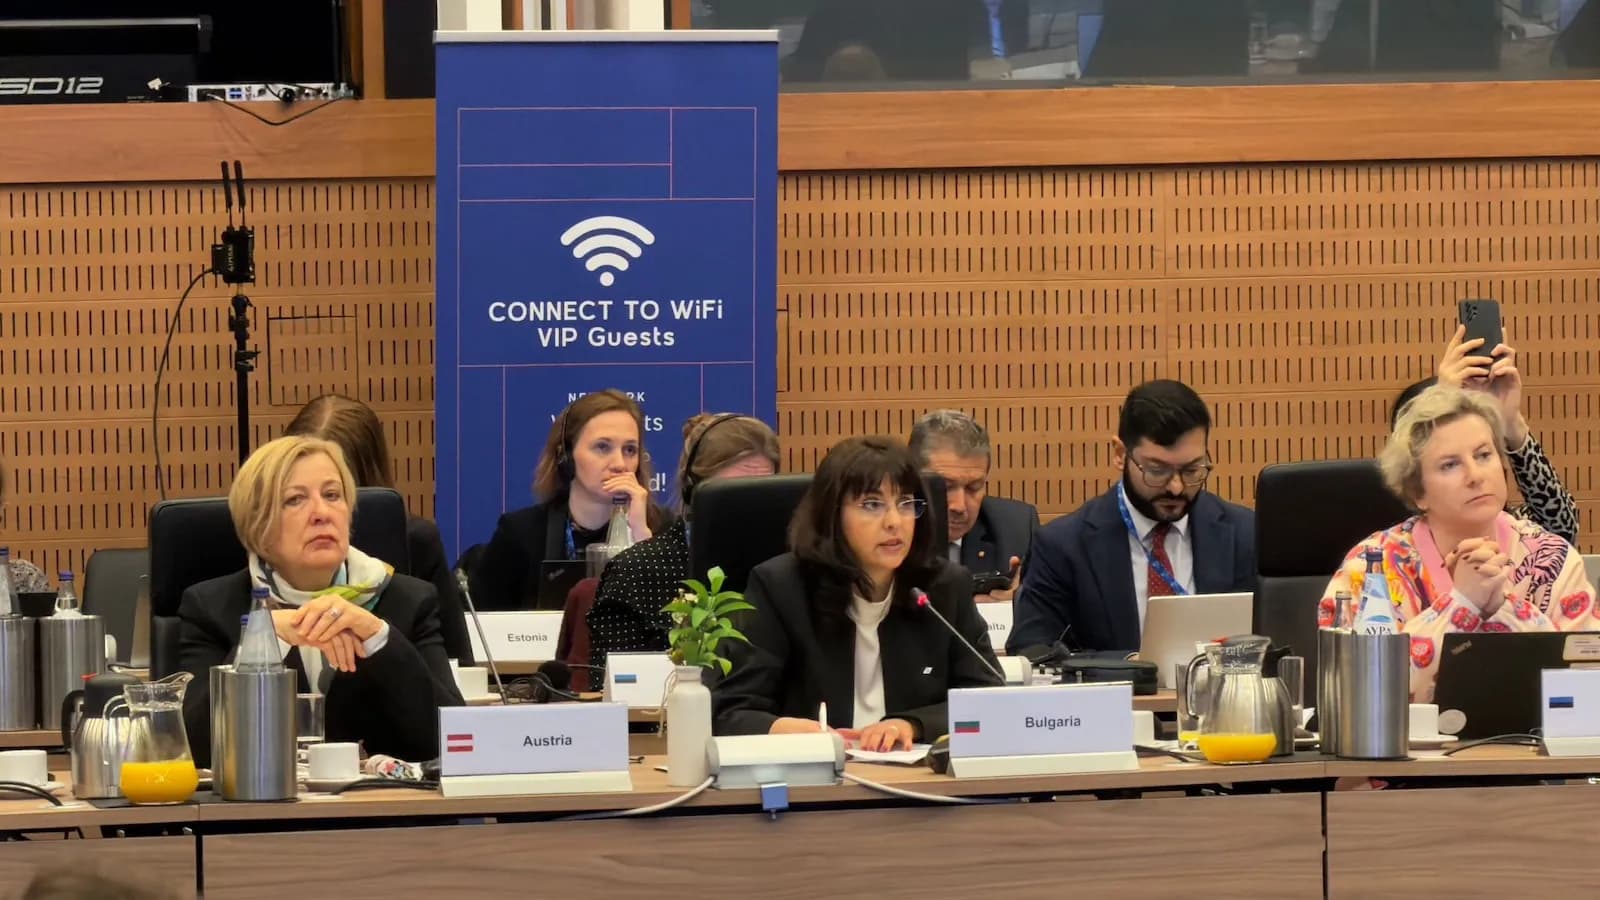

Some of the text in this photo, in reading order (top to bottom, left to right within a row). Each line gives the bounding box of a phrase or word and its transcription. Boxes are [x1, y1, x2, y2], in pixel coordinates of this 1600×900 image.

[488, 299, 723, 322] CONNECT TO WiFi
[537, 326, 675, 347] VIP Guests
[507, 633, 548, 642] Estonia
[1025, 715, 1081, 730] Bulgaria
[523, 734, 572, 747] Austria
